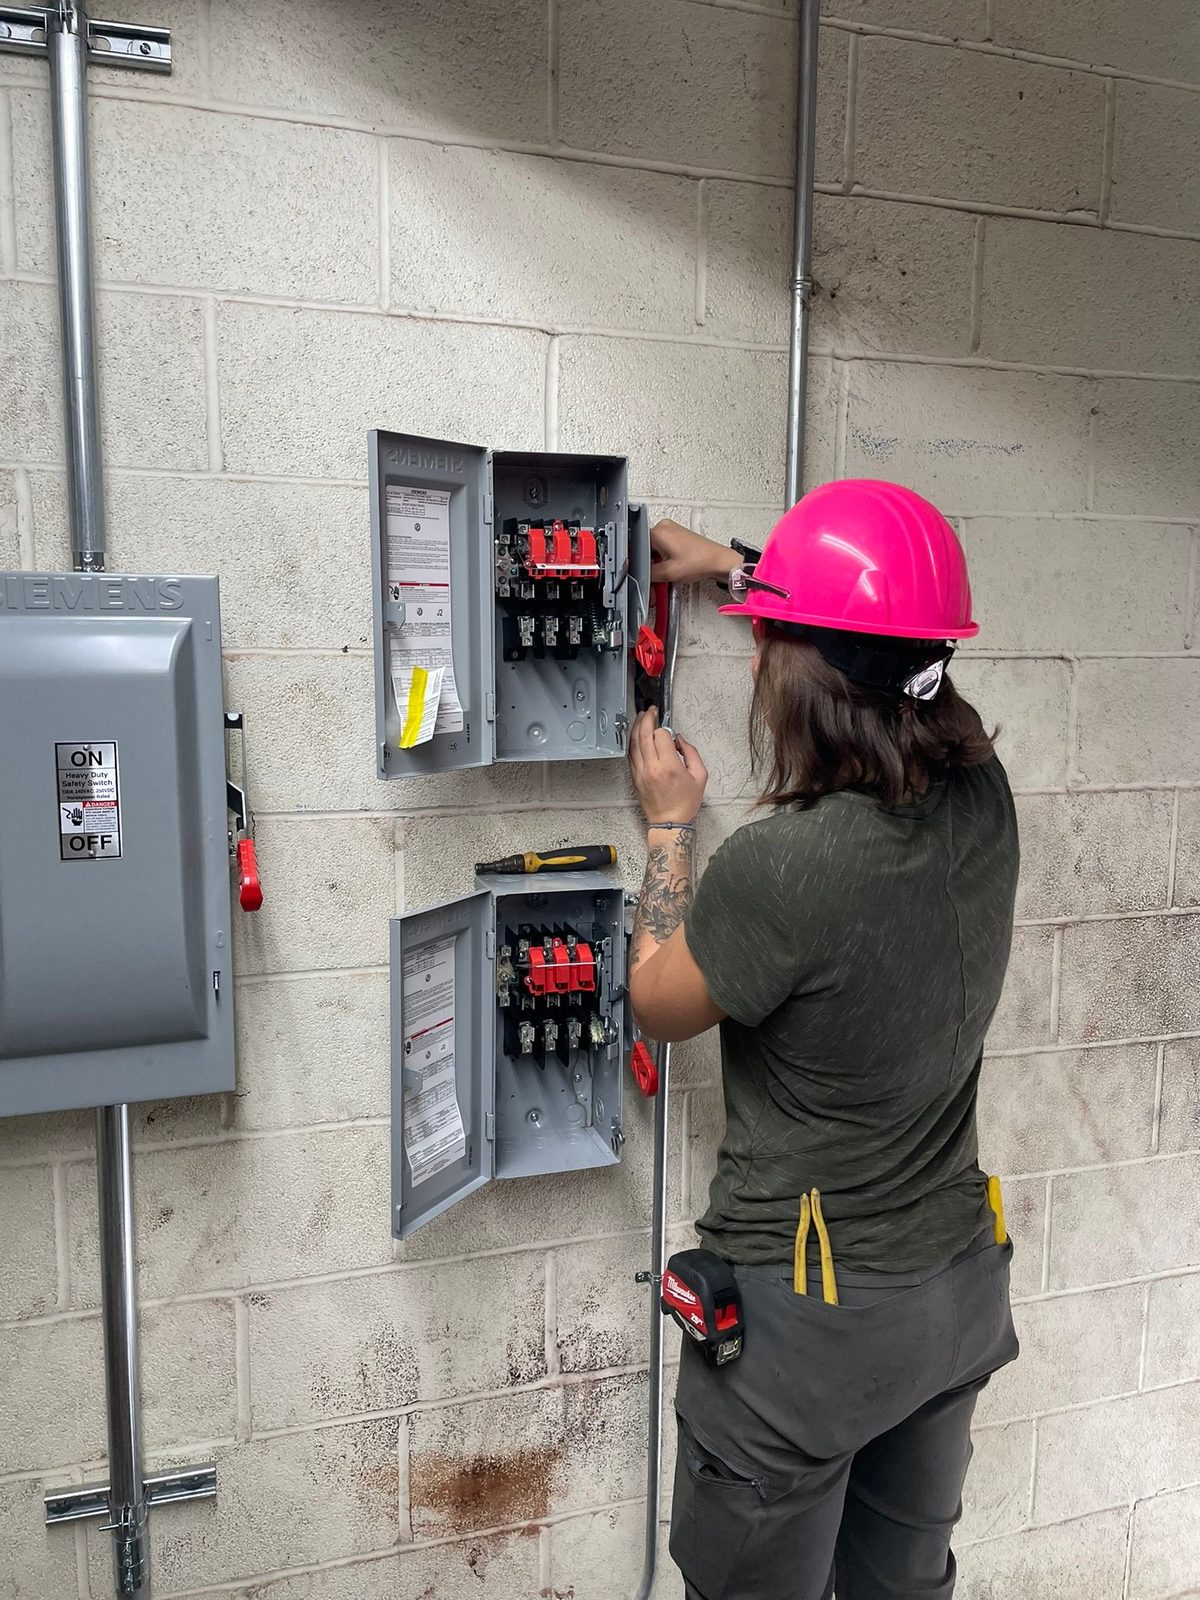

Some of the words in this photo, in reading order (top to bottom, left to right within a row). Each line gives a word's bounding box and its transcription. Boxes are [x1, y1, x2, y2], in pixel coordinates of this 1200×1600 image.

[0, 577, 185, 610] IEMENS
[71, 751, 102, 767] ON
[62, 780, 86, 788] Safety
[88, 779, 113, 787] Switch
[70, 835, 112, 851] OFF
